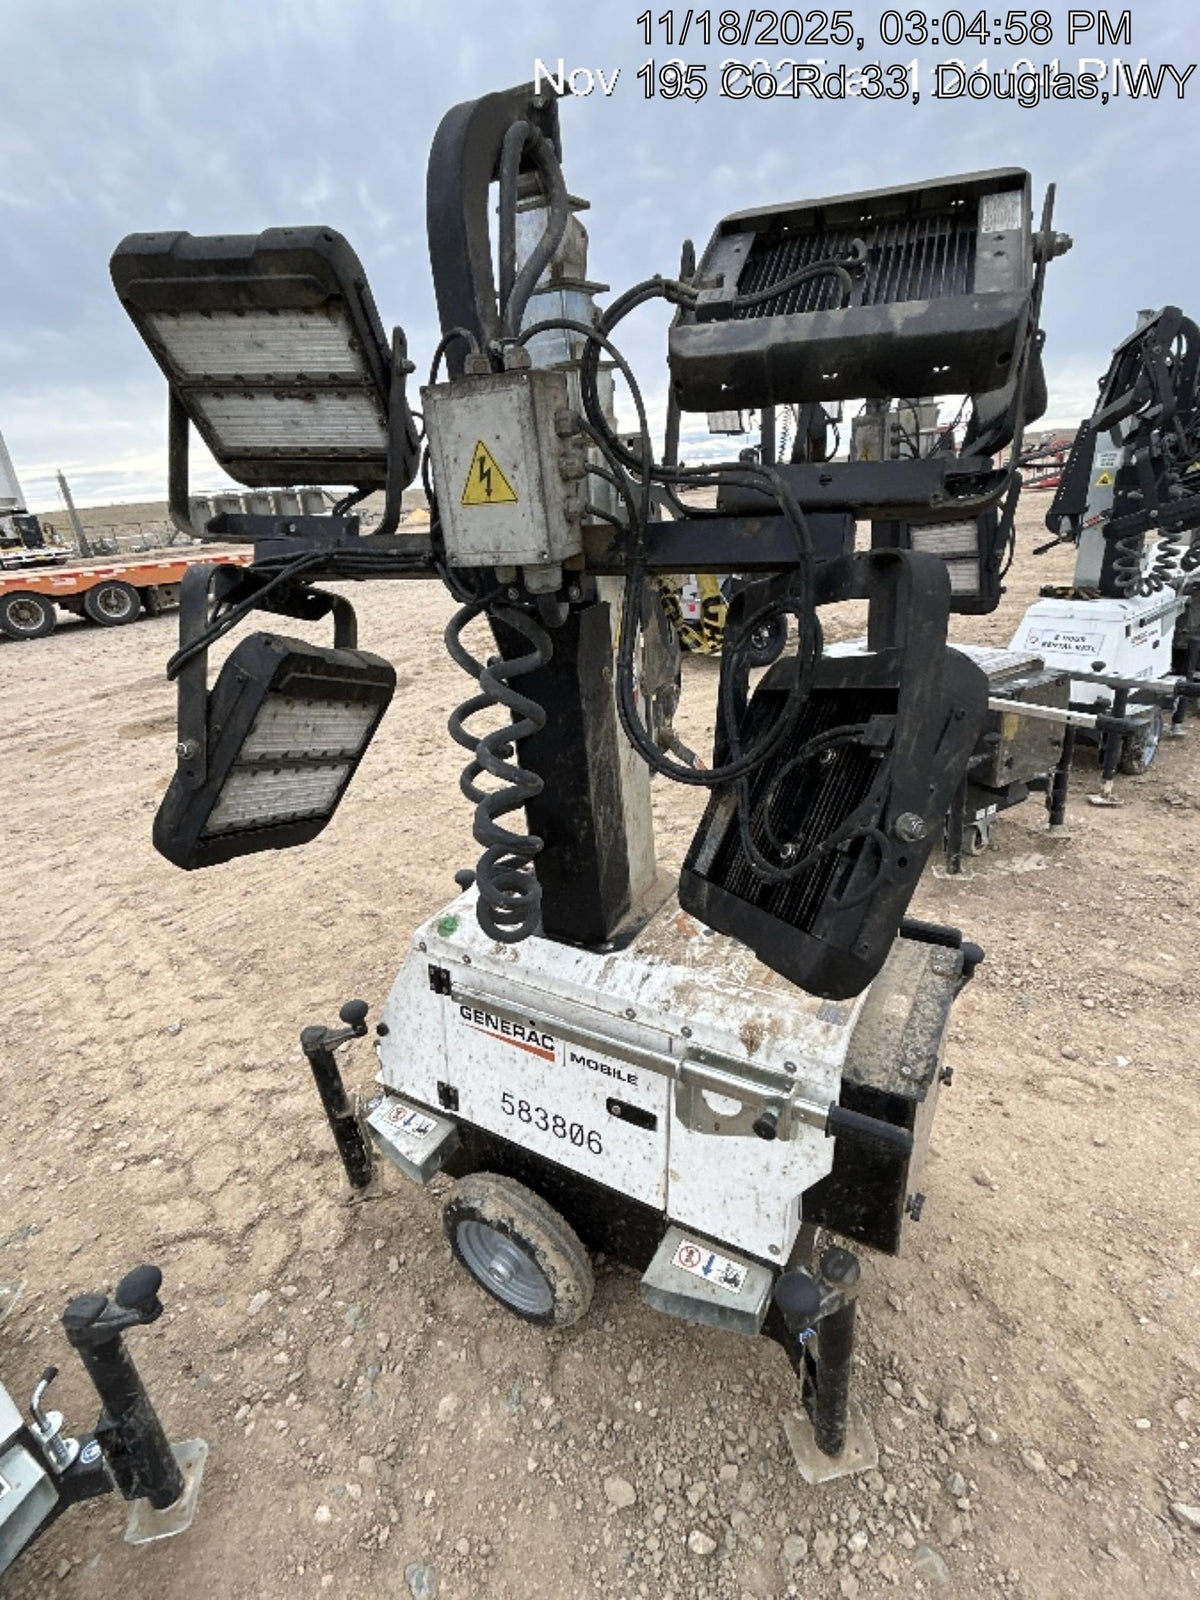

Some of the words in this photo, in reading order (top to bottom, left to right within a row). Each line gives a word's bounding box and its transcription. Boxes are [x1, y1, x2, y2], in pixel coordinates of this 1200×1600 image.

[459, 1005, 556, 1051] GENERAC
[570, 1052, 639, 1086] MOBILE
[501, 1092, 603, 1155] 583806
